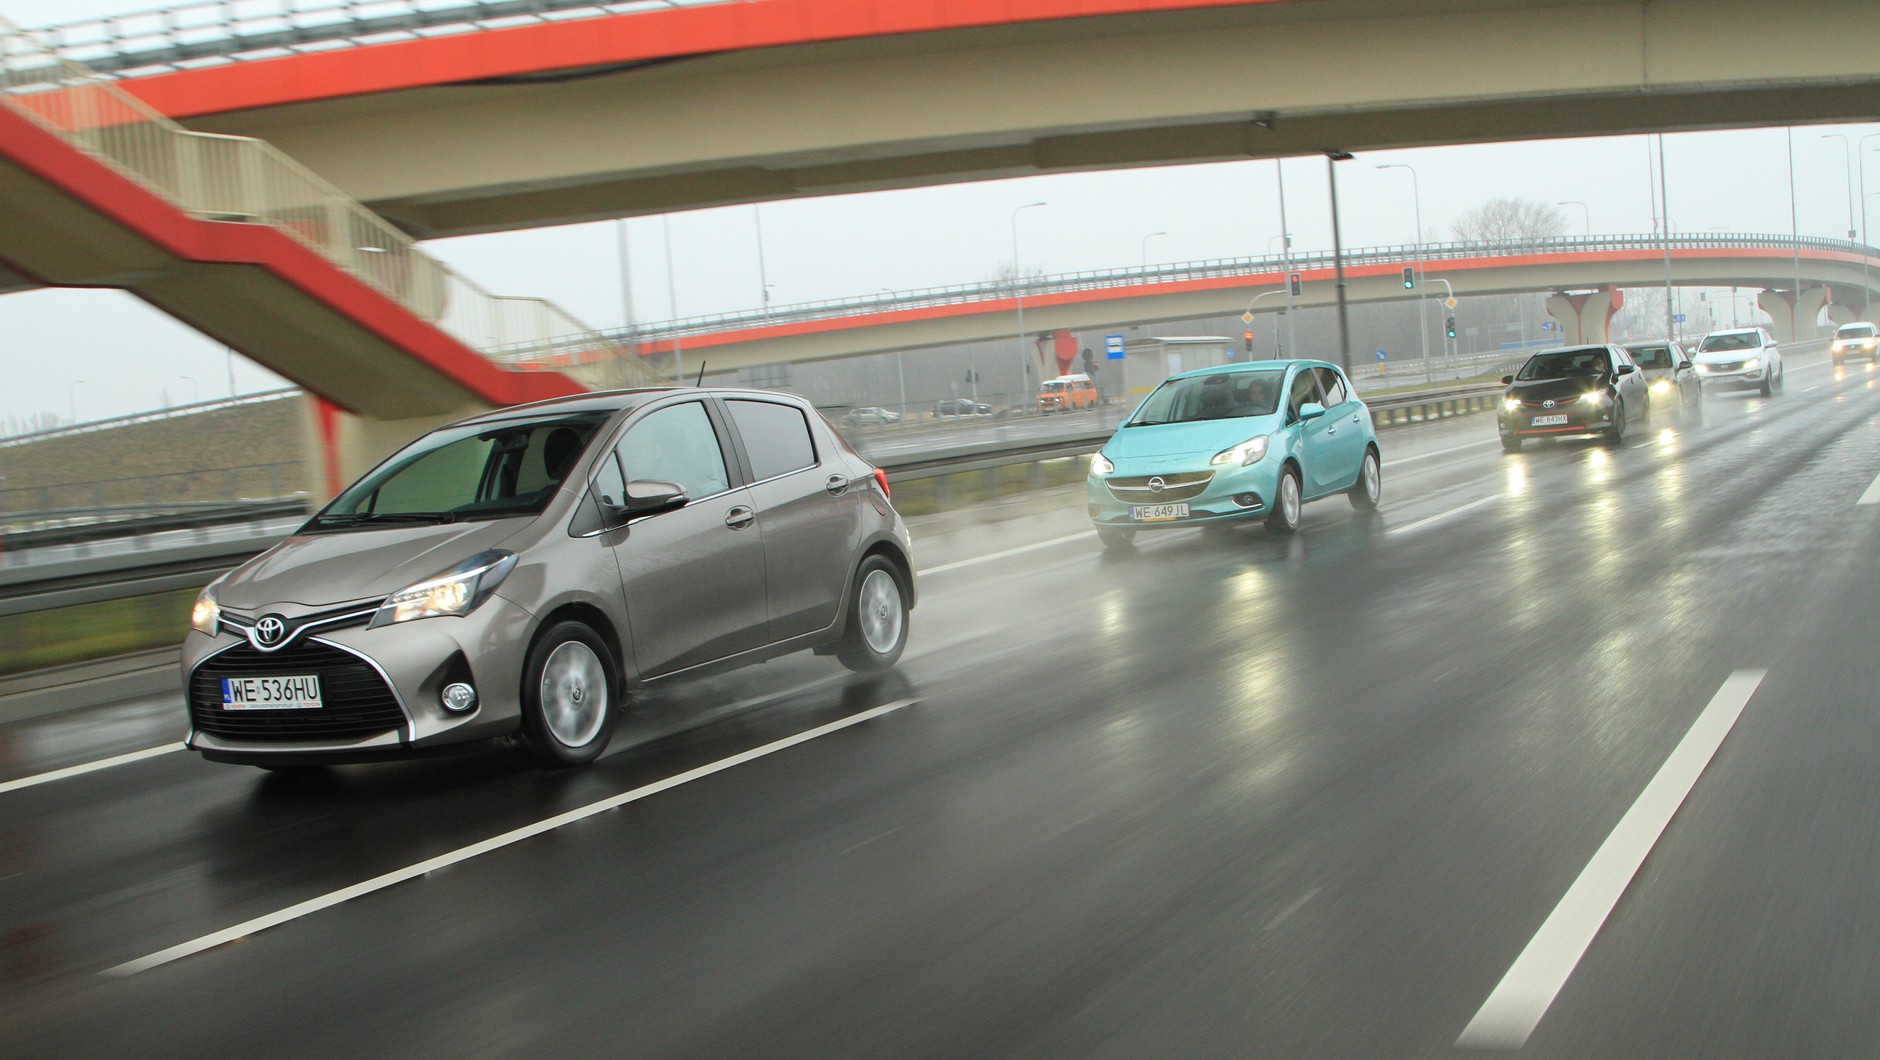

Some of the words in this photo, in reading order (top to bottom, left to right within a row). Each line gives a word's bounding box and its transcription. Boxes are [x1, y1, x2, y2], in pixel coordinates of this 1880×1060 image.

[1135, 507, 1151, 518] WE
[231, 680, 256, 702] WE
[261, 678, 318, 701] 536HU
